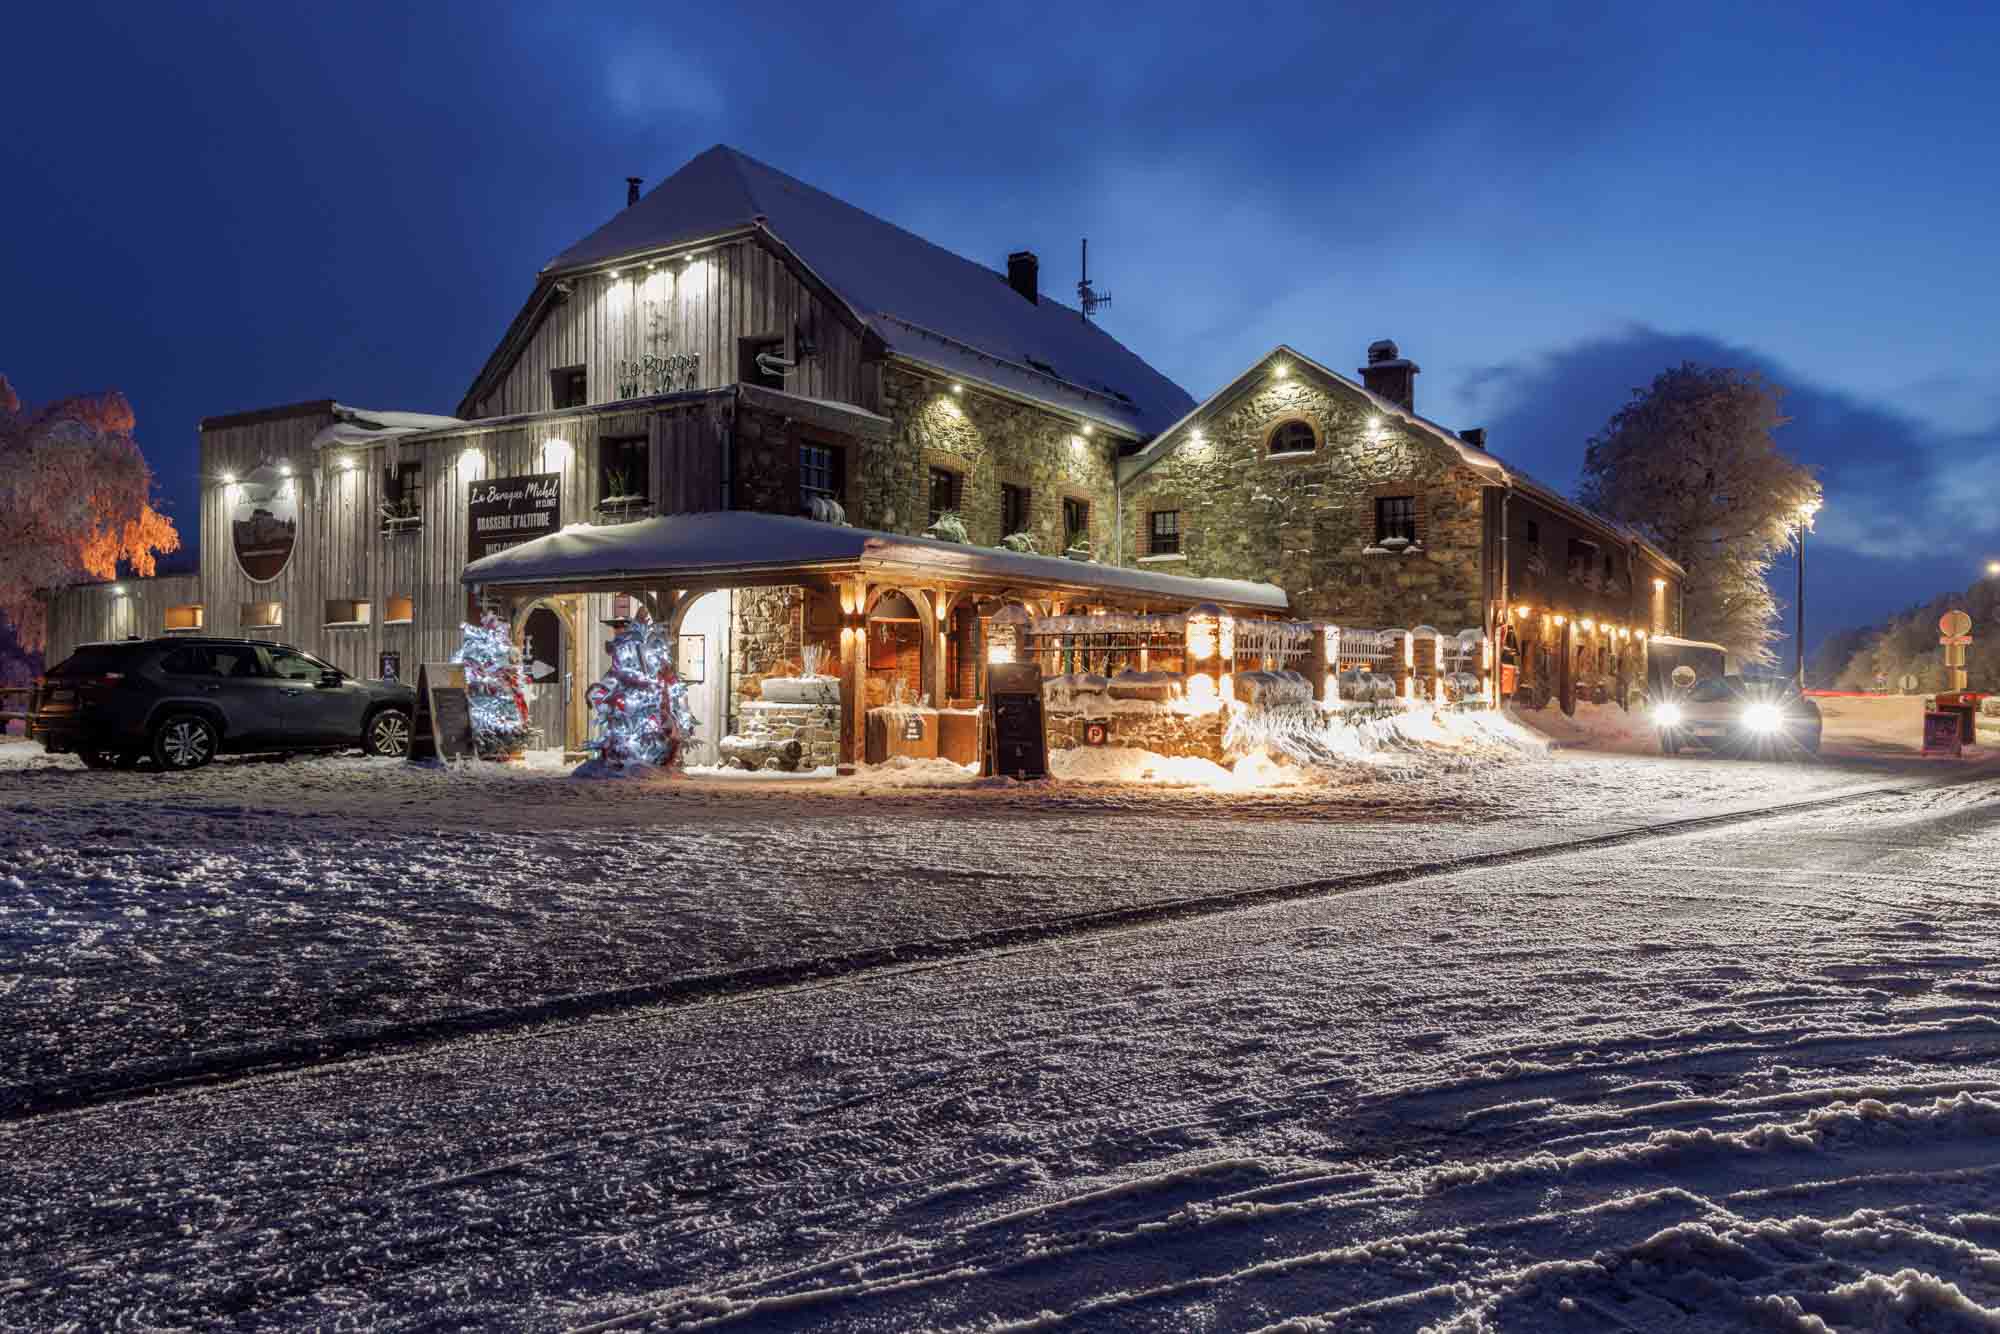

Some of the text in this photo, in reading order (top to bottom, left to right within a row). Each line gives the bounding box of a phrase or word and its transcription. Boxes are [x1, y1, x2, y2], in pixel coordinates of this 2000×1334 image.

[470, 487, 485, 504] La
[486, 486, 523, 509] Baraque
[524, 479, 558, 499] Michel
[477, 511, 550, 531] BRASSERIE D'ALTITUDE
